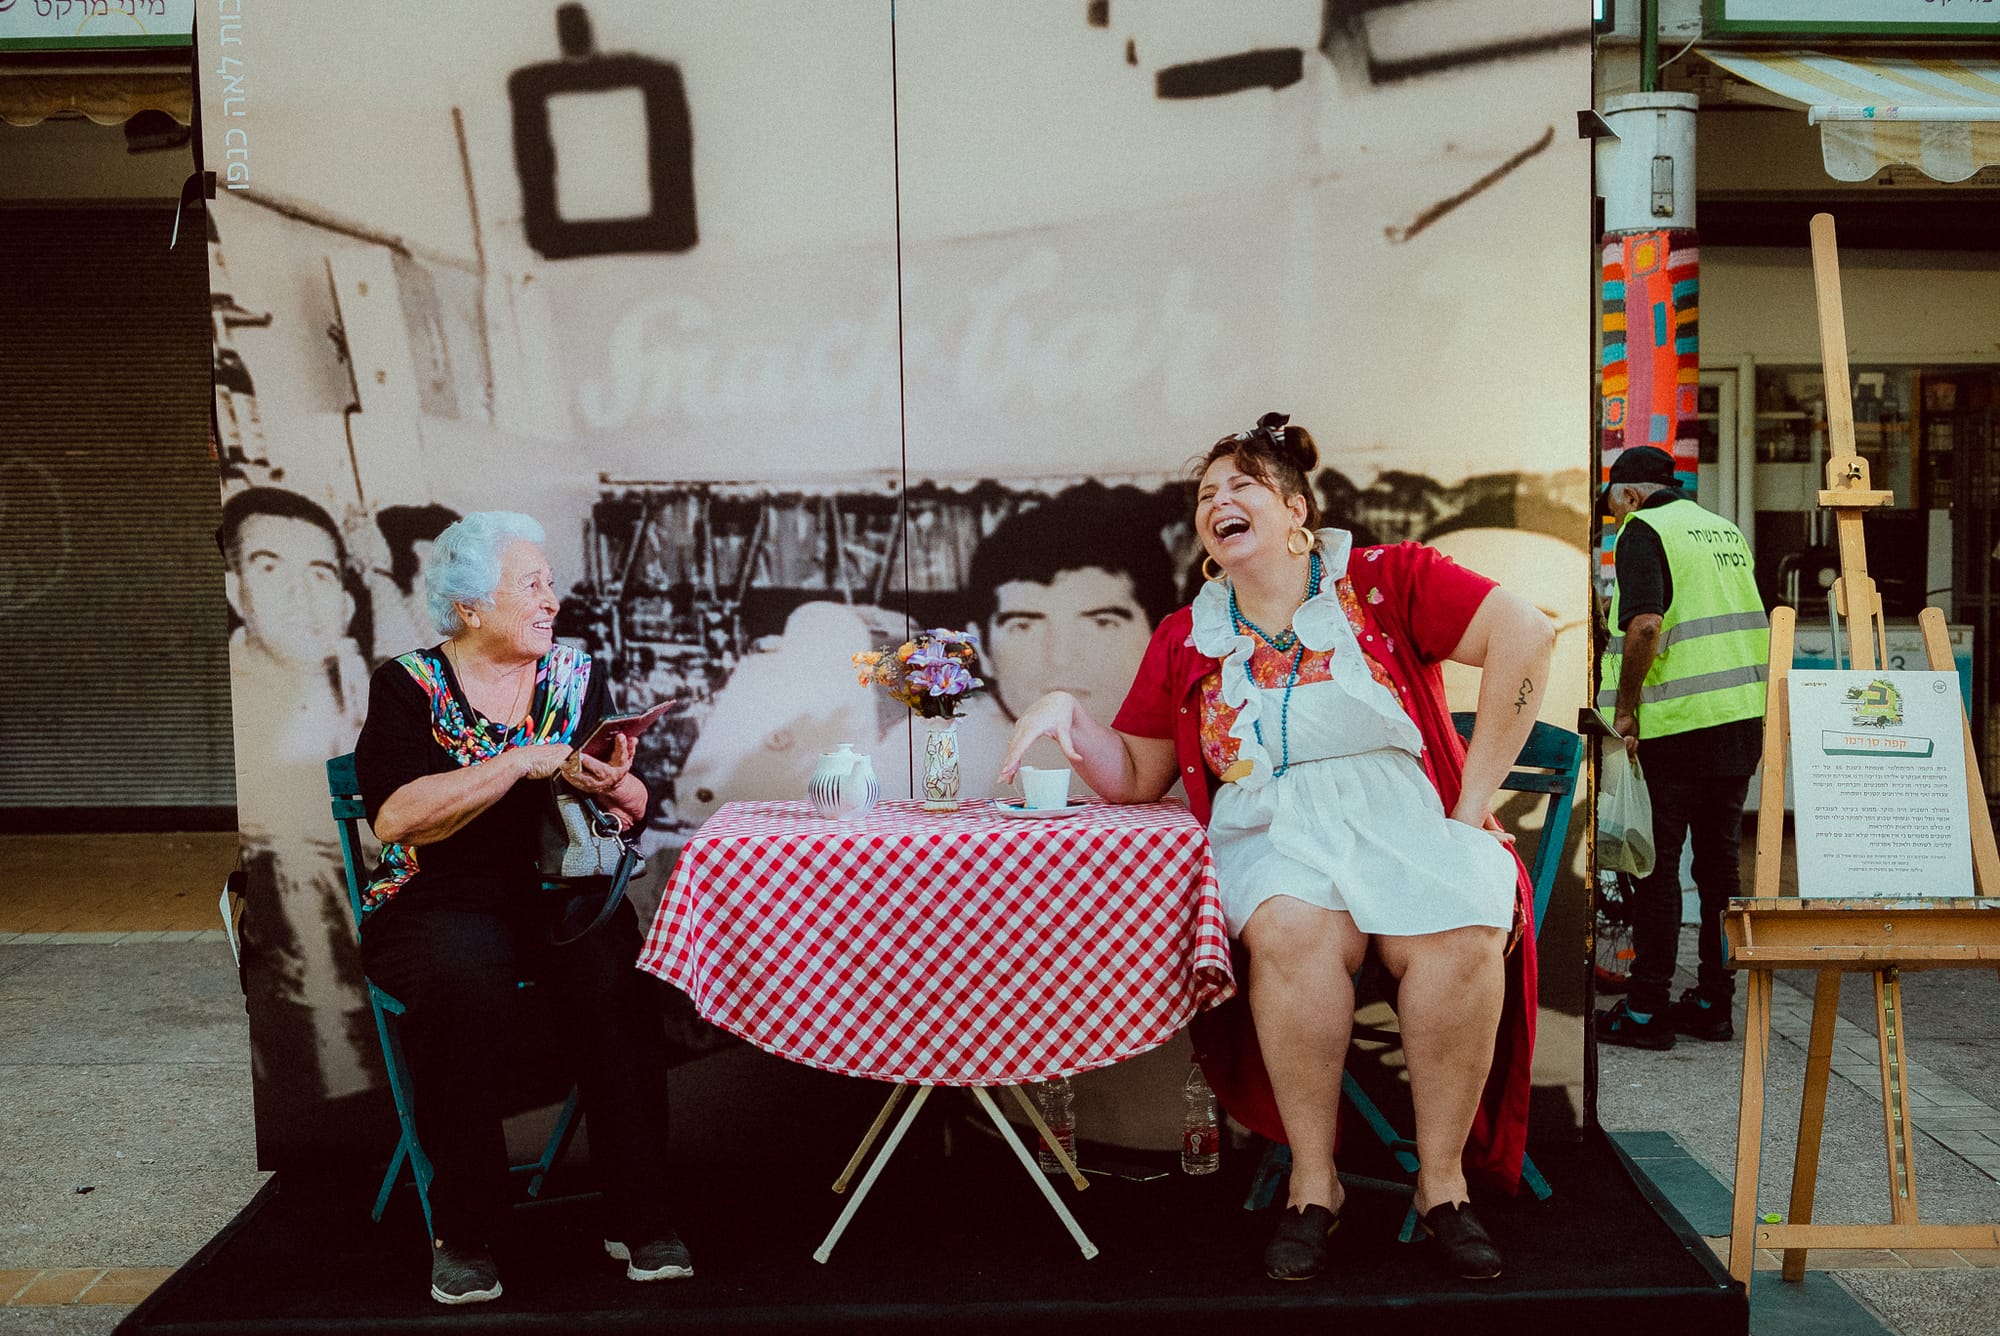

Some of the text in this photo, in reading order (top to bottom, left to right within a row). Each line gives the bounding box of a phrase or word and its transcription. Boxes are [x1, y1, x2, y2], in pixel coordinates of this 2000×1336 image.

[35, 0, 109, 20] מרקט
[216, 56, 246, 116] לאה
[225, 128, 250, 190] כנפו
[1687, 529, 1722, 543] השחר
[1713, 552, 1746, 571] בטחון
[1867, 737, 1880, 747] סן
[1884, 739, 1907, 749] קפה
